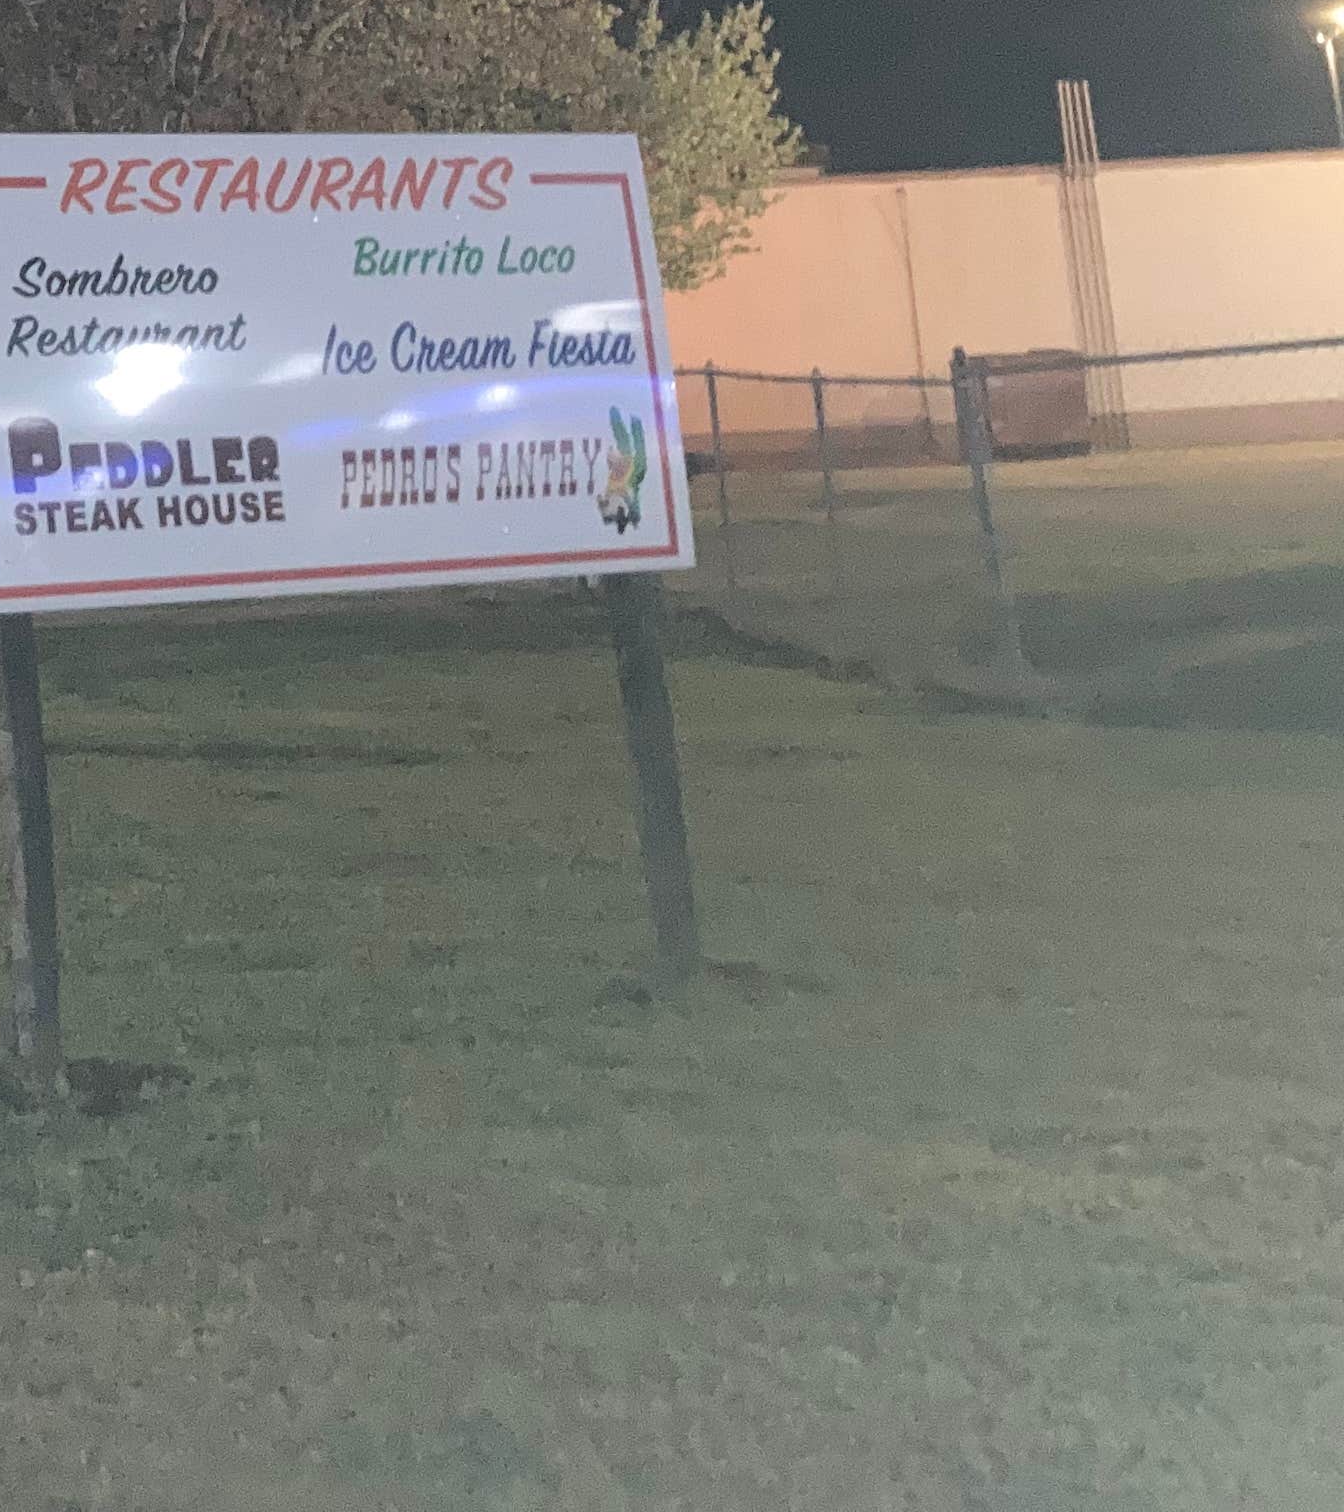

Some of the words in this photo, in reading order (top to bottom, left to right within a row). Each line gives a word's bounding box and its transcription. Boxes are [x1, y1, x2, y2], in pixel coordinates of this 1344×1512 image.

[60, 156, 515, 215] RESTAURANTS
[12, 253, 218, 298] Sombrero
[353, 235, 484, 276] Burrito
[497, 235, 575, 275] Loco
[7, 313, 247, 358] Restaurant
[322, 323, 377, 375] Ice
[391, 320, 516, 373] Cream
[528, 317, 636, 368] Fiesta
[341, 444, 461, 509] PEDRO'S
[476, 438, 602, 501] PANTRY
[14, 498, 144, 536] STEAK
[157, 490, 287, 529] HOUSE
